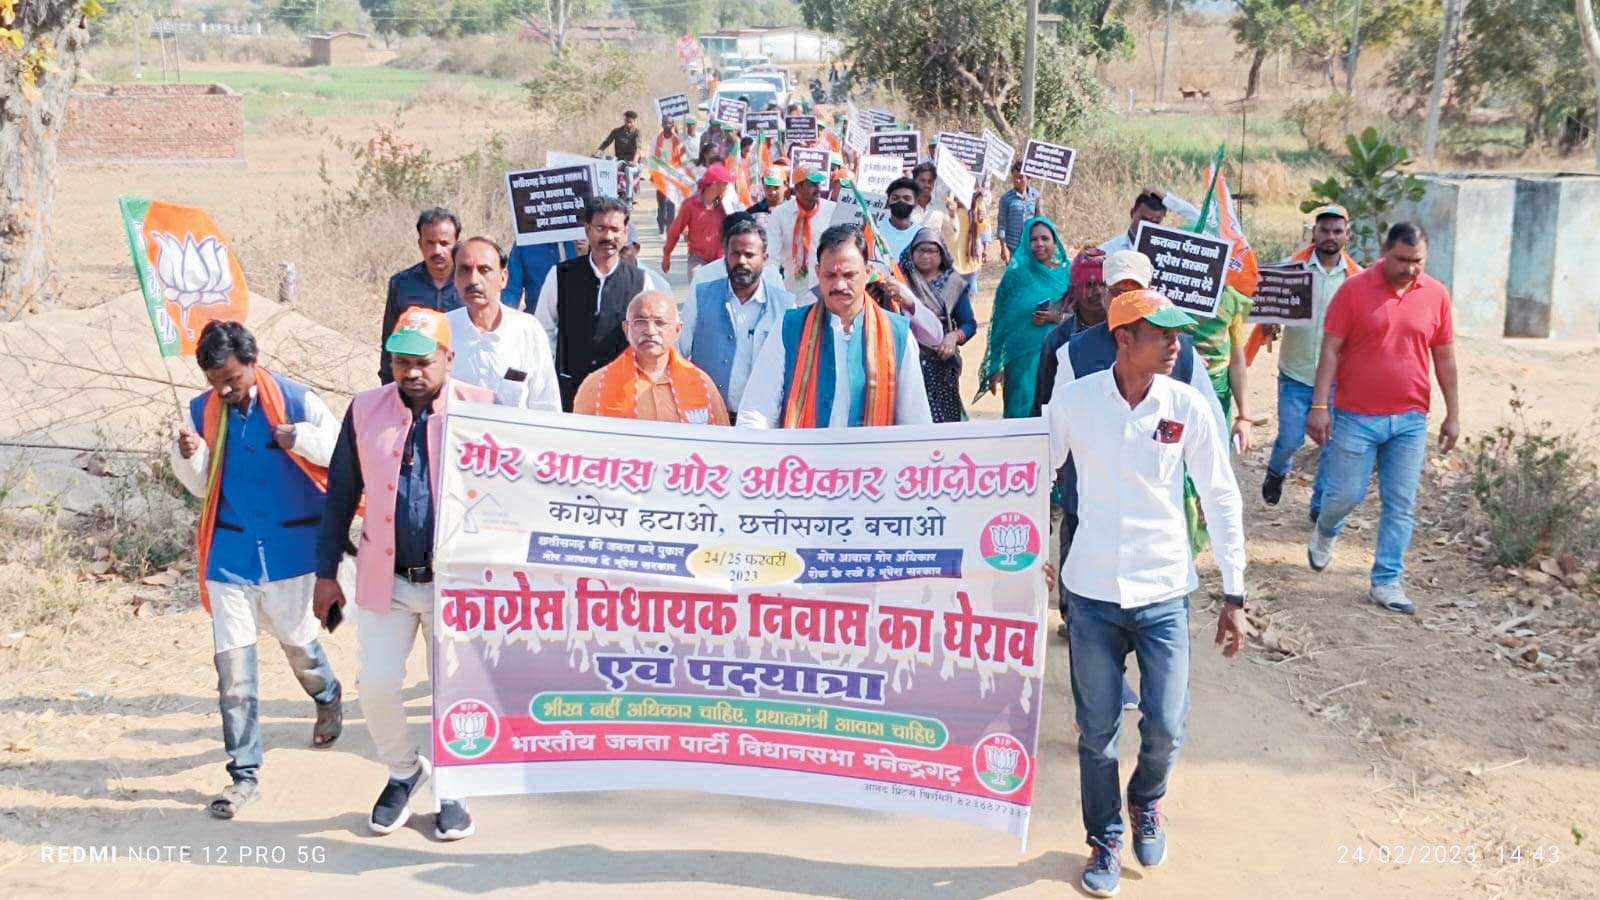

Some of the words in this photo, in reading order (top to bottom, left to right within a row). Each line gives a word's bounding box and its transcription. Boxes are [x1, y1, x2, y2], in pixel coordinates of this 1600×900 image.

[1155, 252, 1181, 268] भूपेश
[1181, 258, 1209, 273] सरकार
[1184, 289, 1216, 307] अधिकार
[457, 432, 523, 480] मोर
[534, 449, 656, 491] आवास
[665, 452, 731, 496] मोर
[740, 454, 886, 498] अधिकार
[897, 449, 1038, 499] आंदोलन
[549, 495, 628, 527] कांग्रेस
[638, 503, 725, 537] हटाओ,
[738, 508, 854, 543] छत्तीसगढ़
[864, 506, 947, 537] बचाओ
[588, 536, 603, 550] की
[657, 545, 685, 560] पुकार
[703, 550, 741, 567] 24/25
[745, 550, 787, 567] फरवरी
[817, 549, 835, 563] मोर
[839, 551, 873, 563] आवास
[875, 550, 893, 563] मोर
[896, 550, 938, 563] अधिकार
[729, 569, 759, 582] 2023
[831, 566, 844, 579] के
[879, 565, 904, 580] भूपेश
[906, 565, 943, 577] सरकार
[441, 570, 566, 635] कांग्रेस
[575, 576, 739, 636] विधायक
[748, 592, 870, 647] निवास
[878, 604, 935, 652] का
[943, 590, 1039, 667] घेराव
[595, 644, 675, 691] एवं
[686, 656, 886, 702] पदयात्रा
[543, 697, 583, 717] भीख
[590, 696, 623, 719] नहीं
[627, 697, 692, 718] अधिकार
[755, 706, 828, 731] प्रधानमंत्री
[835, 715, 885, 737] आवास
[892, 719, 937, 745] चाहिए
[511, 730, 596, 754] भारतीय
[605, 733, 672, 752] जनता
[679, 731, 730, 756] पार्टी
[737, 733, 855, 768] विधानसभा
[863, 748, 963, 787] मनेन्द्रगढ़
